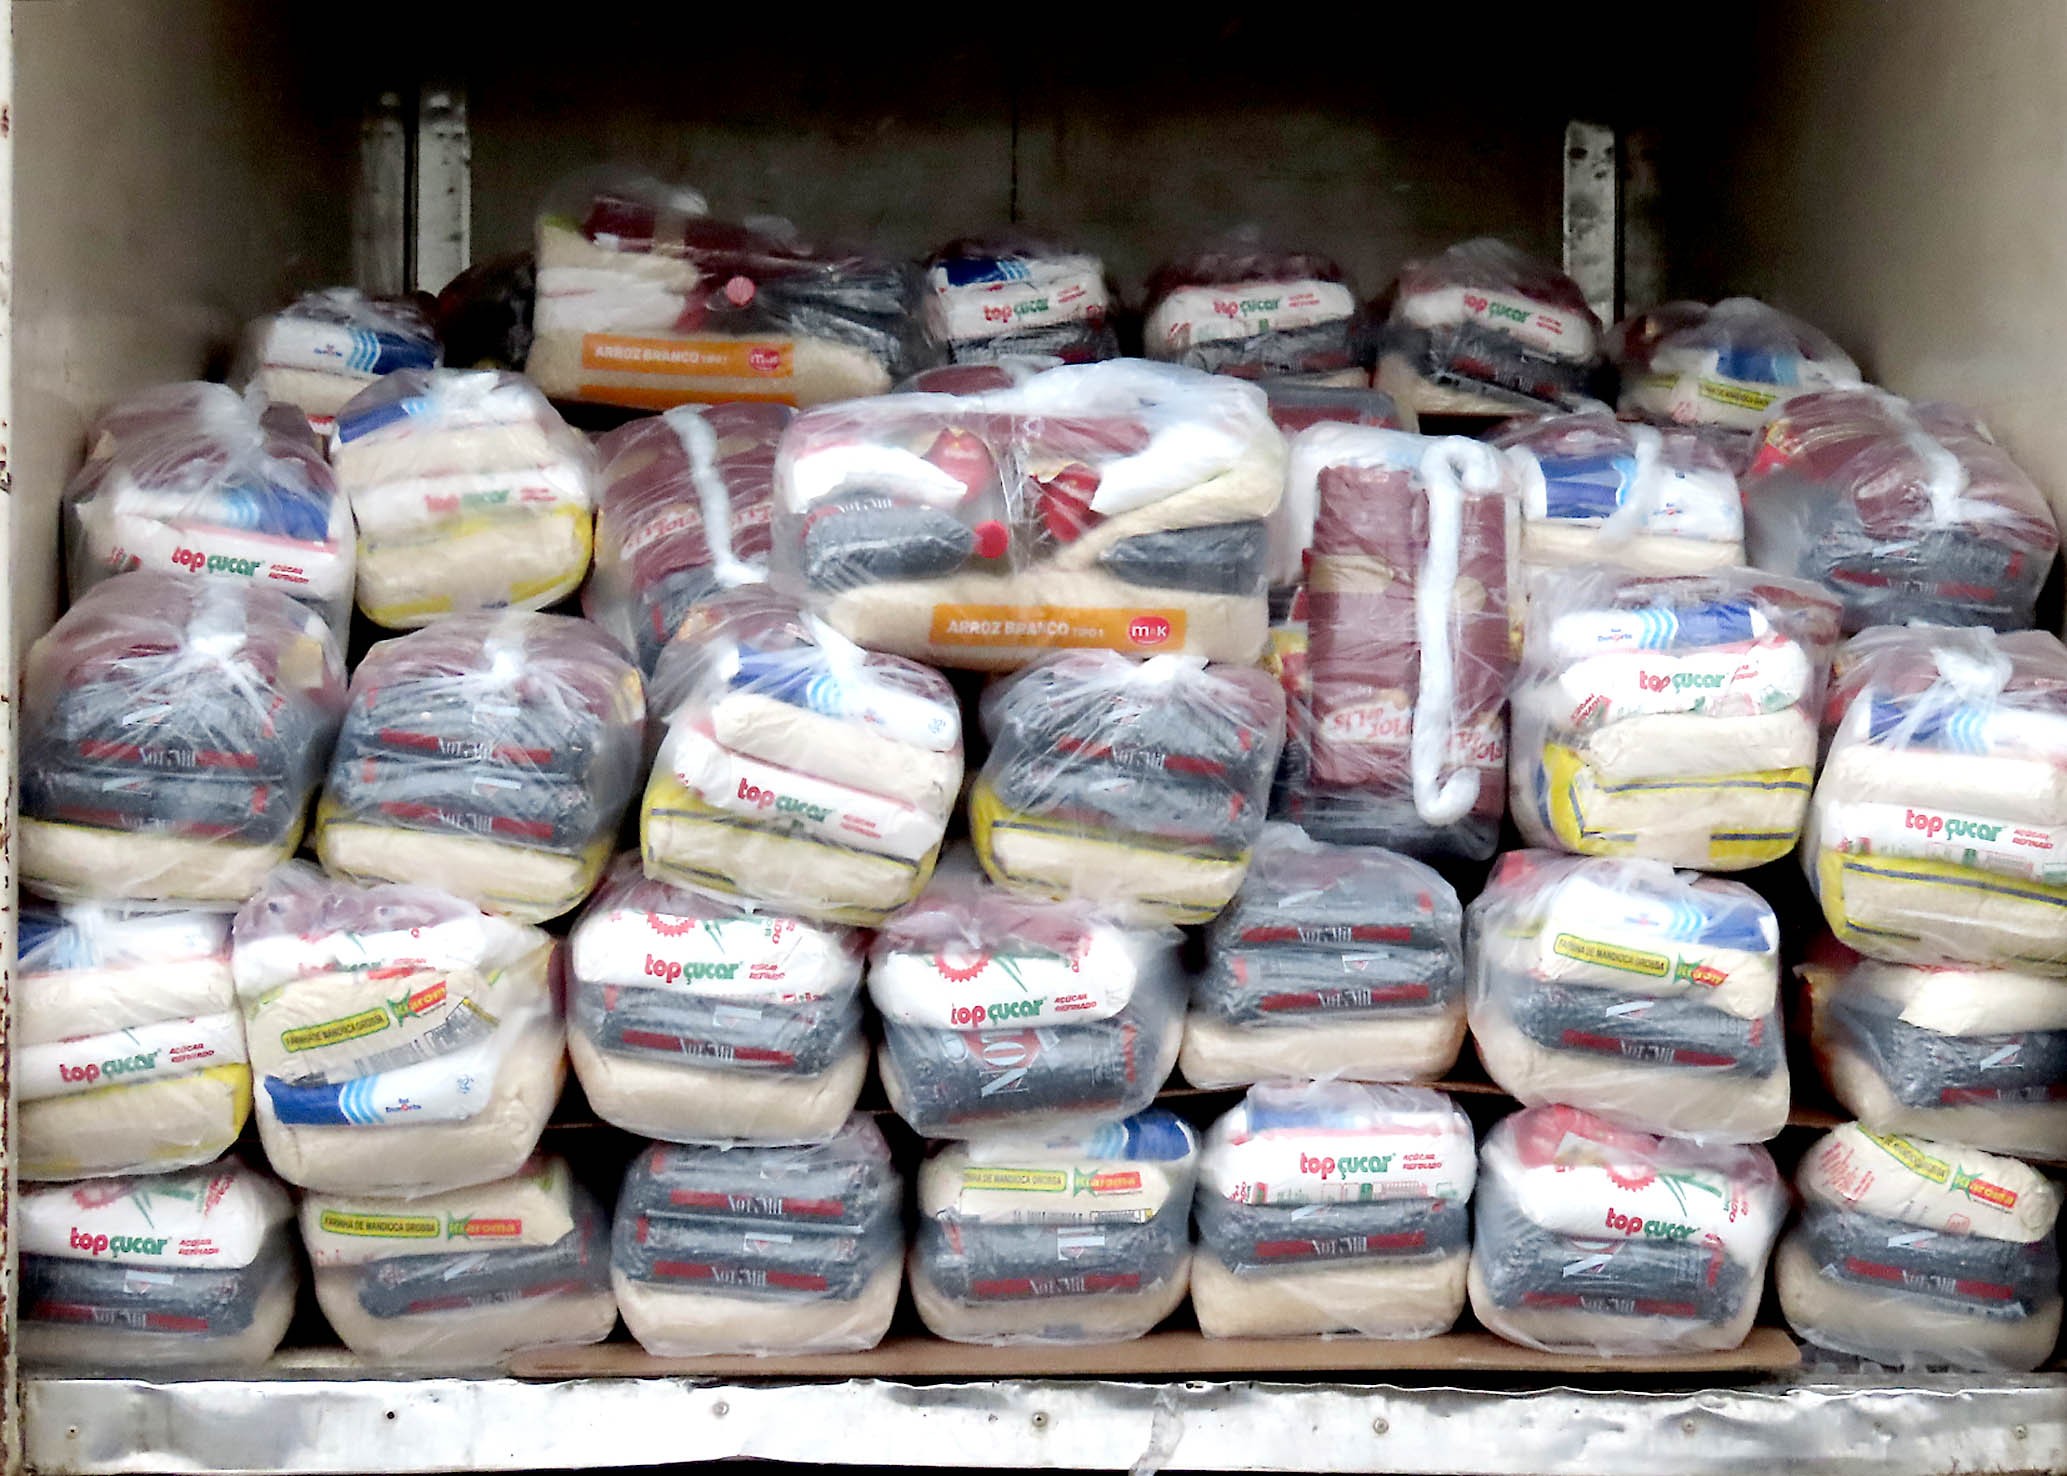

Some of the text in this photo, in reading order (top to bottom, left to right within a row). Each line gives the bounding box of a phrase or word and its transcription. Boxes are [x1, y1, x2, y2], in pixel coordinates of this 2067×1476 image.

[643, 348, 700, 363] BRANCO
[947, 620, 1001, 635] ARROZ
[1300, 1152, 1393, 1180] topçucar
[70, 1227, 168, 1258] topçucar
